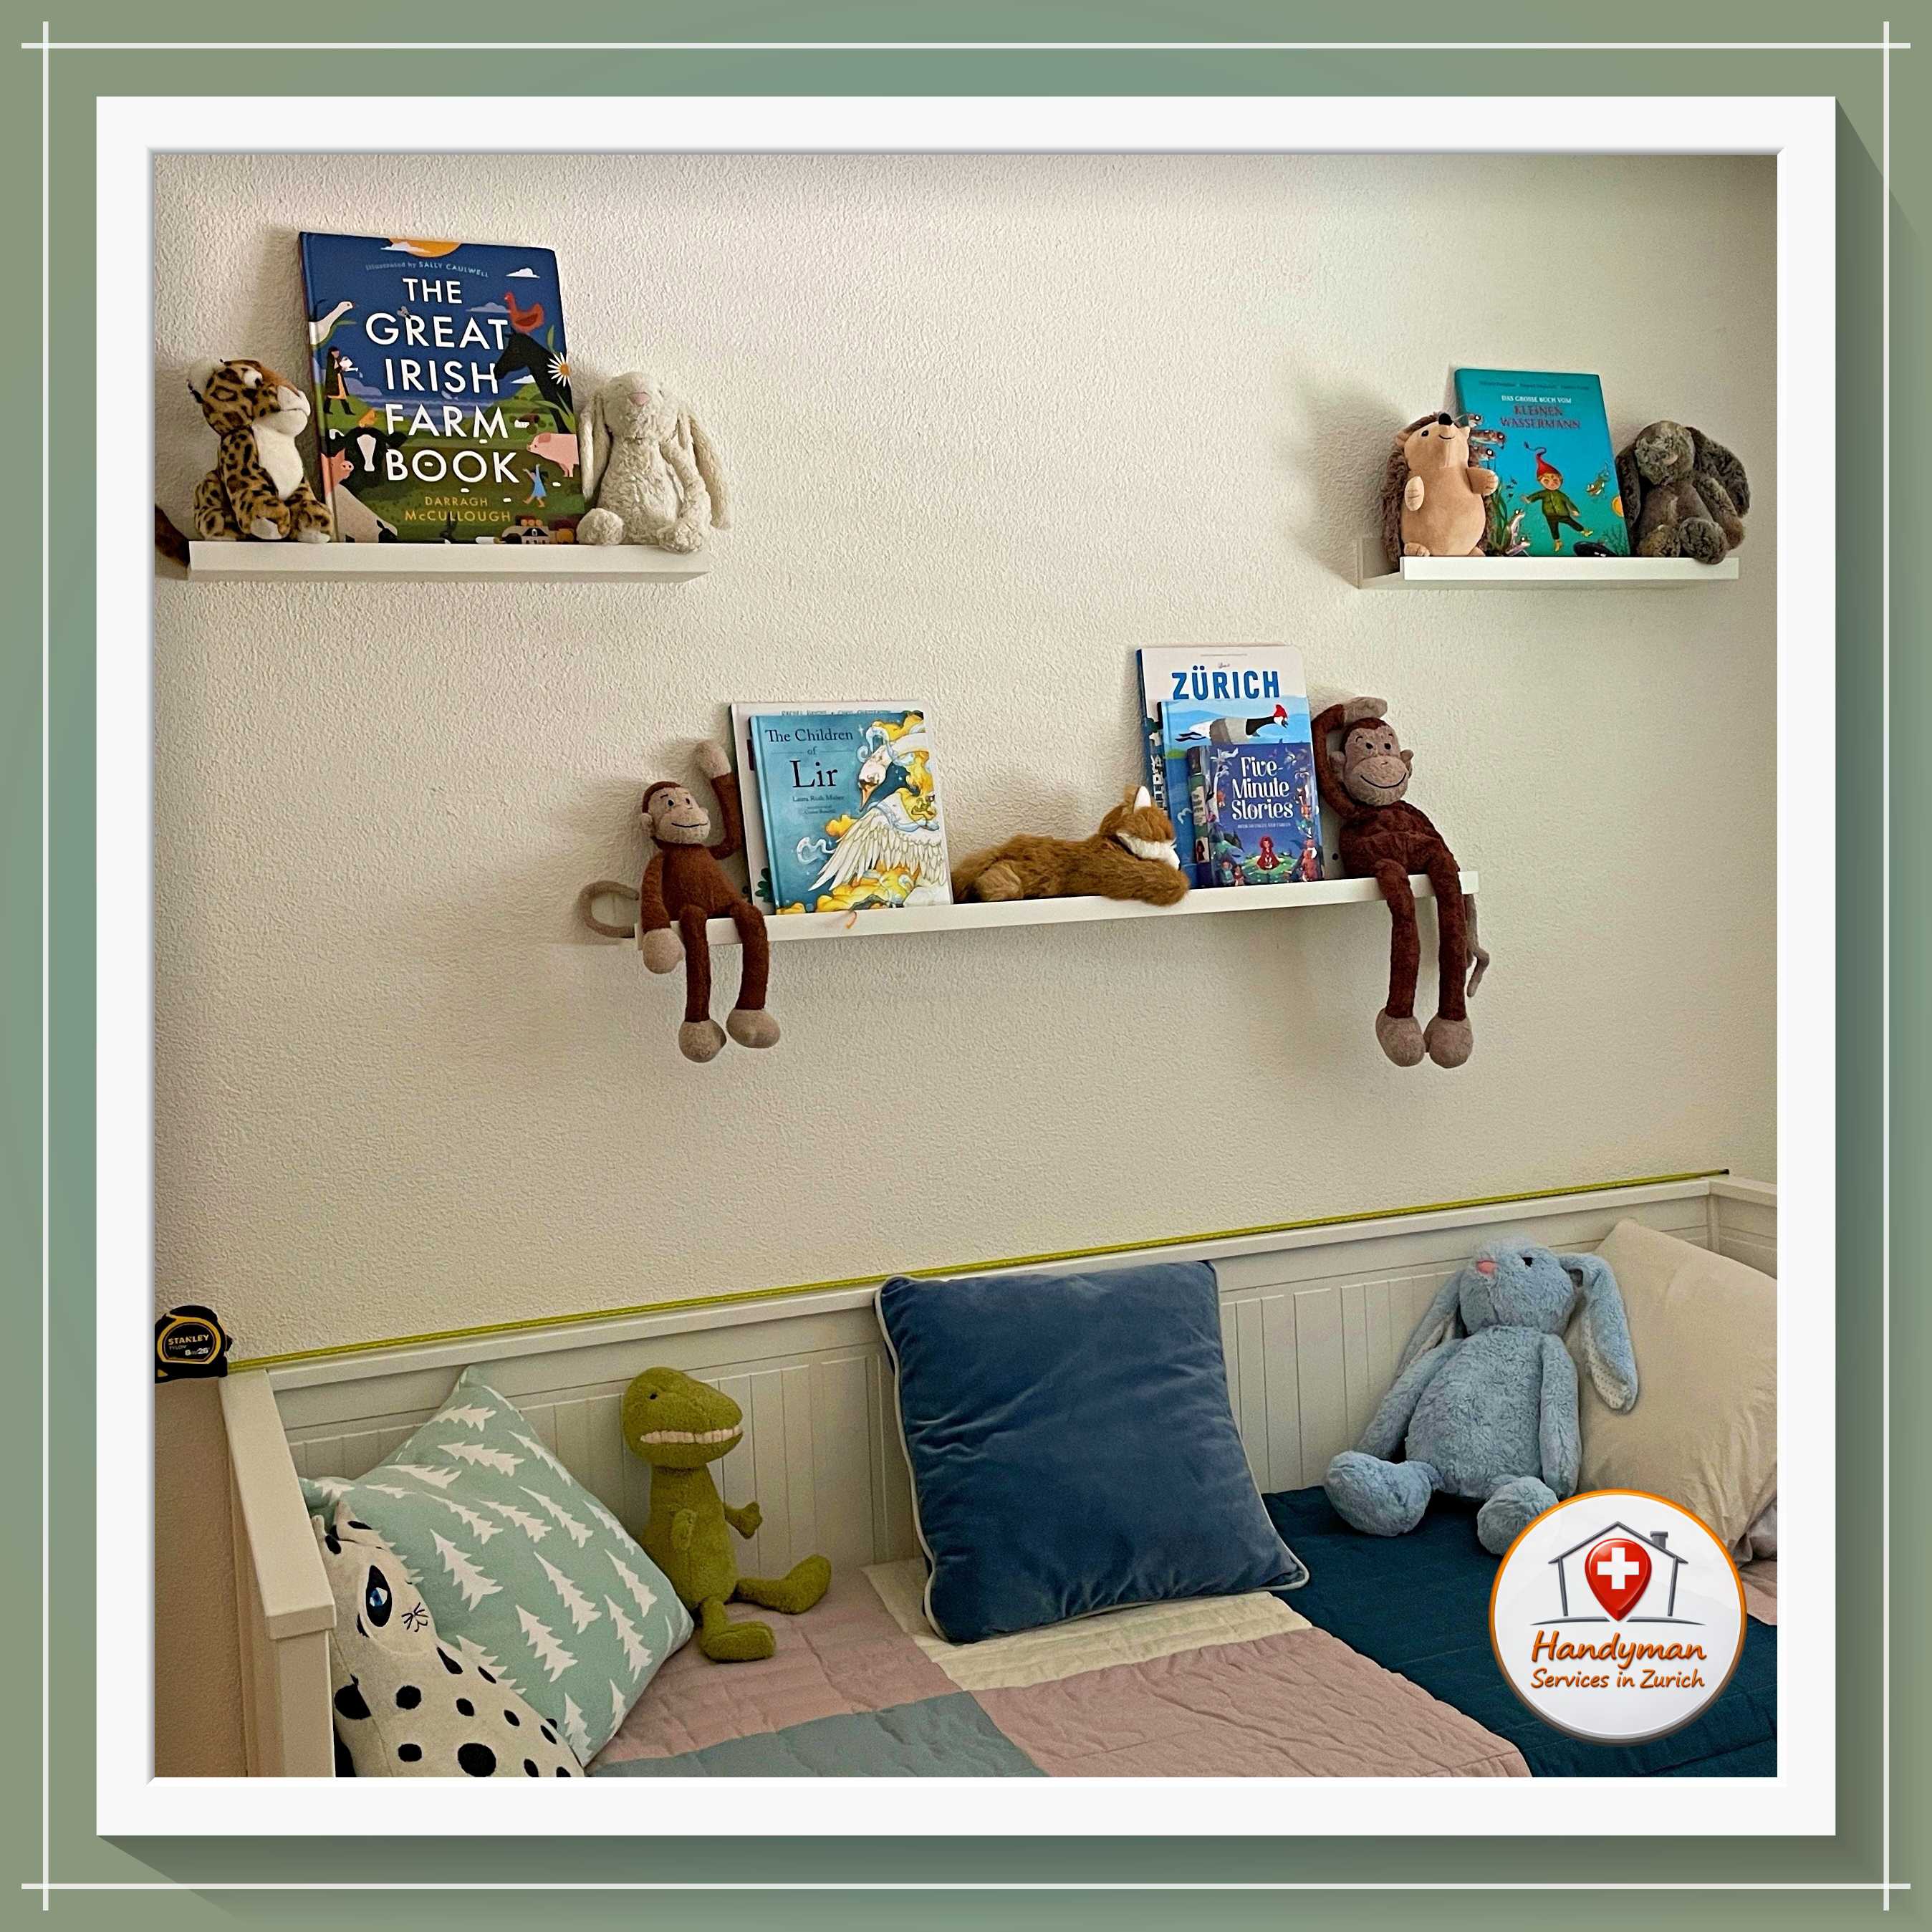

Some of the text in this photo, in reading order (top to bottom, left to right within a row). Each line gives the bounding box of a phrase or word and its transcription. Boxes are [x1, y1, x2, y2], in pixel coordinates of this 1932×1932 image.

[365, 261, 406, 271] Illustrated
[446, 262, 489, 278] CAULWELL
[402, 277, 463, 304] THE
[365, 312, 509, 350] GREAT
[385, 357, 499, 395] IRISH
[1514, 404, 1563, 416] KLEINEN
[385, 403, 509, 439] FARM
[1501, 417, 1580, 429] WASSERMANN
[385, 448, 520, 484] BOOK
[424, 495, 489, 509] DARRAGH
[404, 509, 511, 523] McCULLOUGH
[1171, 665, 1280, 701] ZÜRICH
[764, 729, 854, 742] The Children
[807, 746, 817, 756] of
[789, 759, 838, 789] Lir
[1241, 756, 1284, 777] Five-
[1232, 777, 1289, 799] Minute
[1231, 799, 1294, 820] Stories
[168, 1334, 209, 1345] STANLEY
